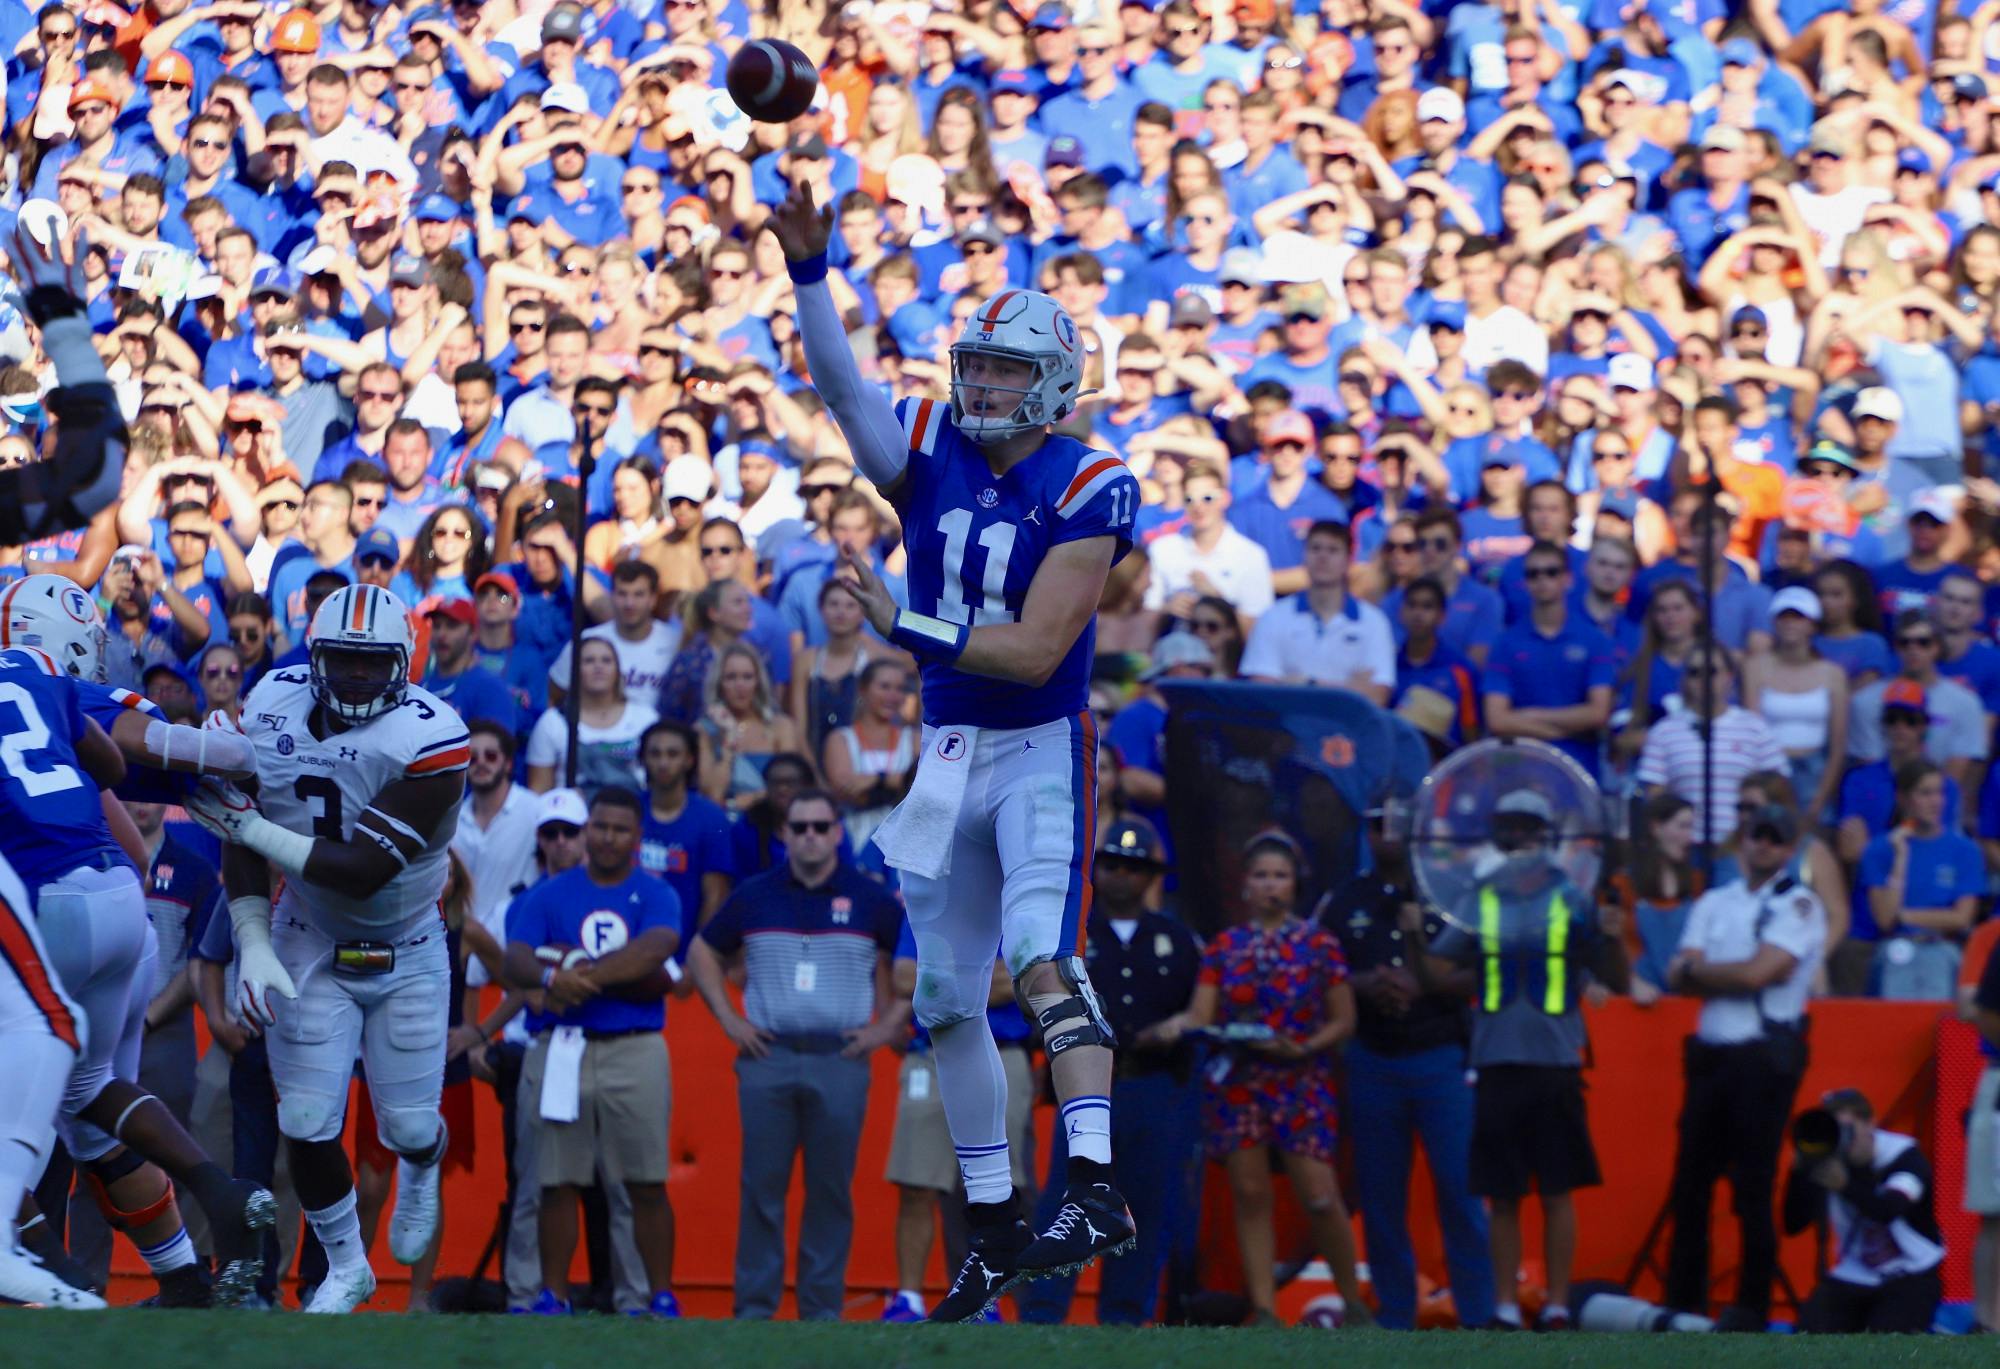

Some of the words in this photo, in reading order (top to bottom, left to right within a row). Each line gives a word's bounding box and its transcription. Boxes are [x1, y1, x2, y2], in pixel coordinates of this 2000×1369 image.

[1062, 317, 1075, 343] F
[981, 487, 999, 504] SEC
[1106, 482, 1132, 527] 11
[936, 507, 1018, 628] 11
[71, 593, 84, 615] F
[273, 670, 308, 685] 3
[404, 699, 436, 721] 3
[0, 681, 85, 798] 2
[943, 737, 960, 754] F
[296, 755, 337, 768] AUBURN
[294, 774, 344, 843] 3
[595, 921, 614, 952] F
